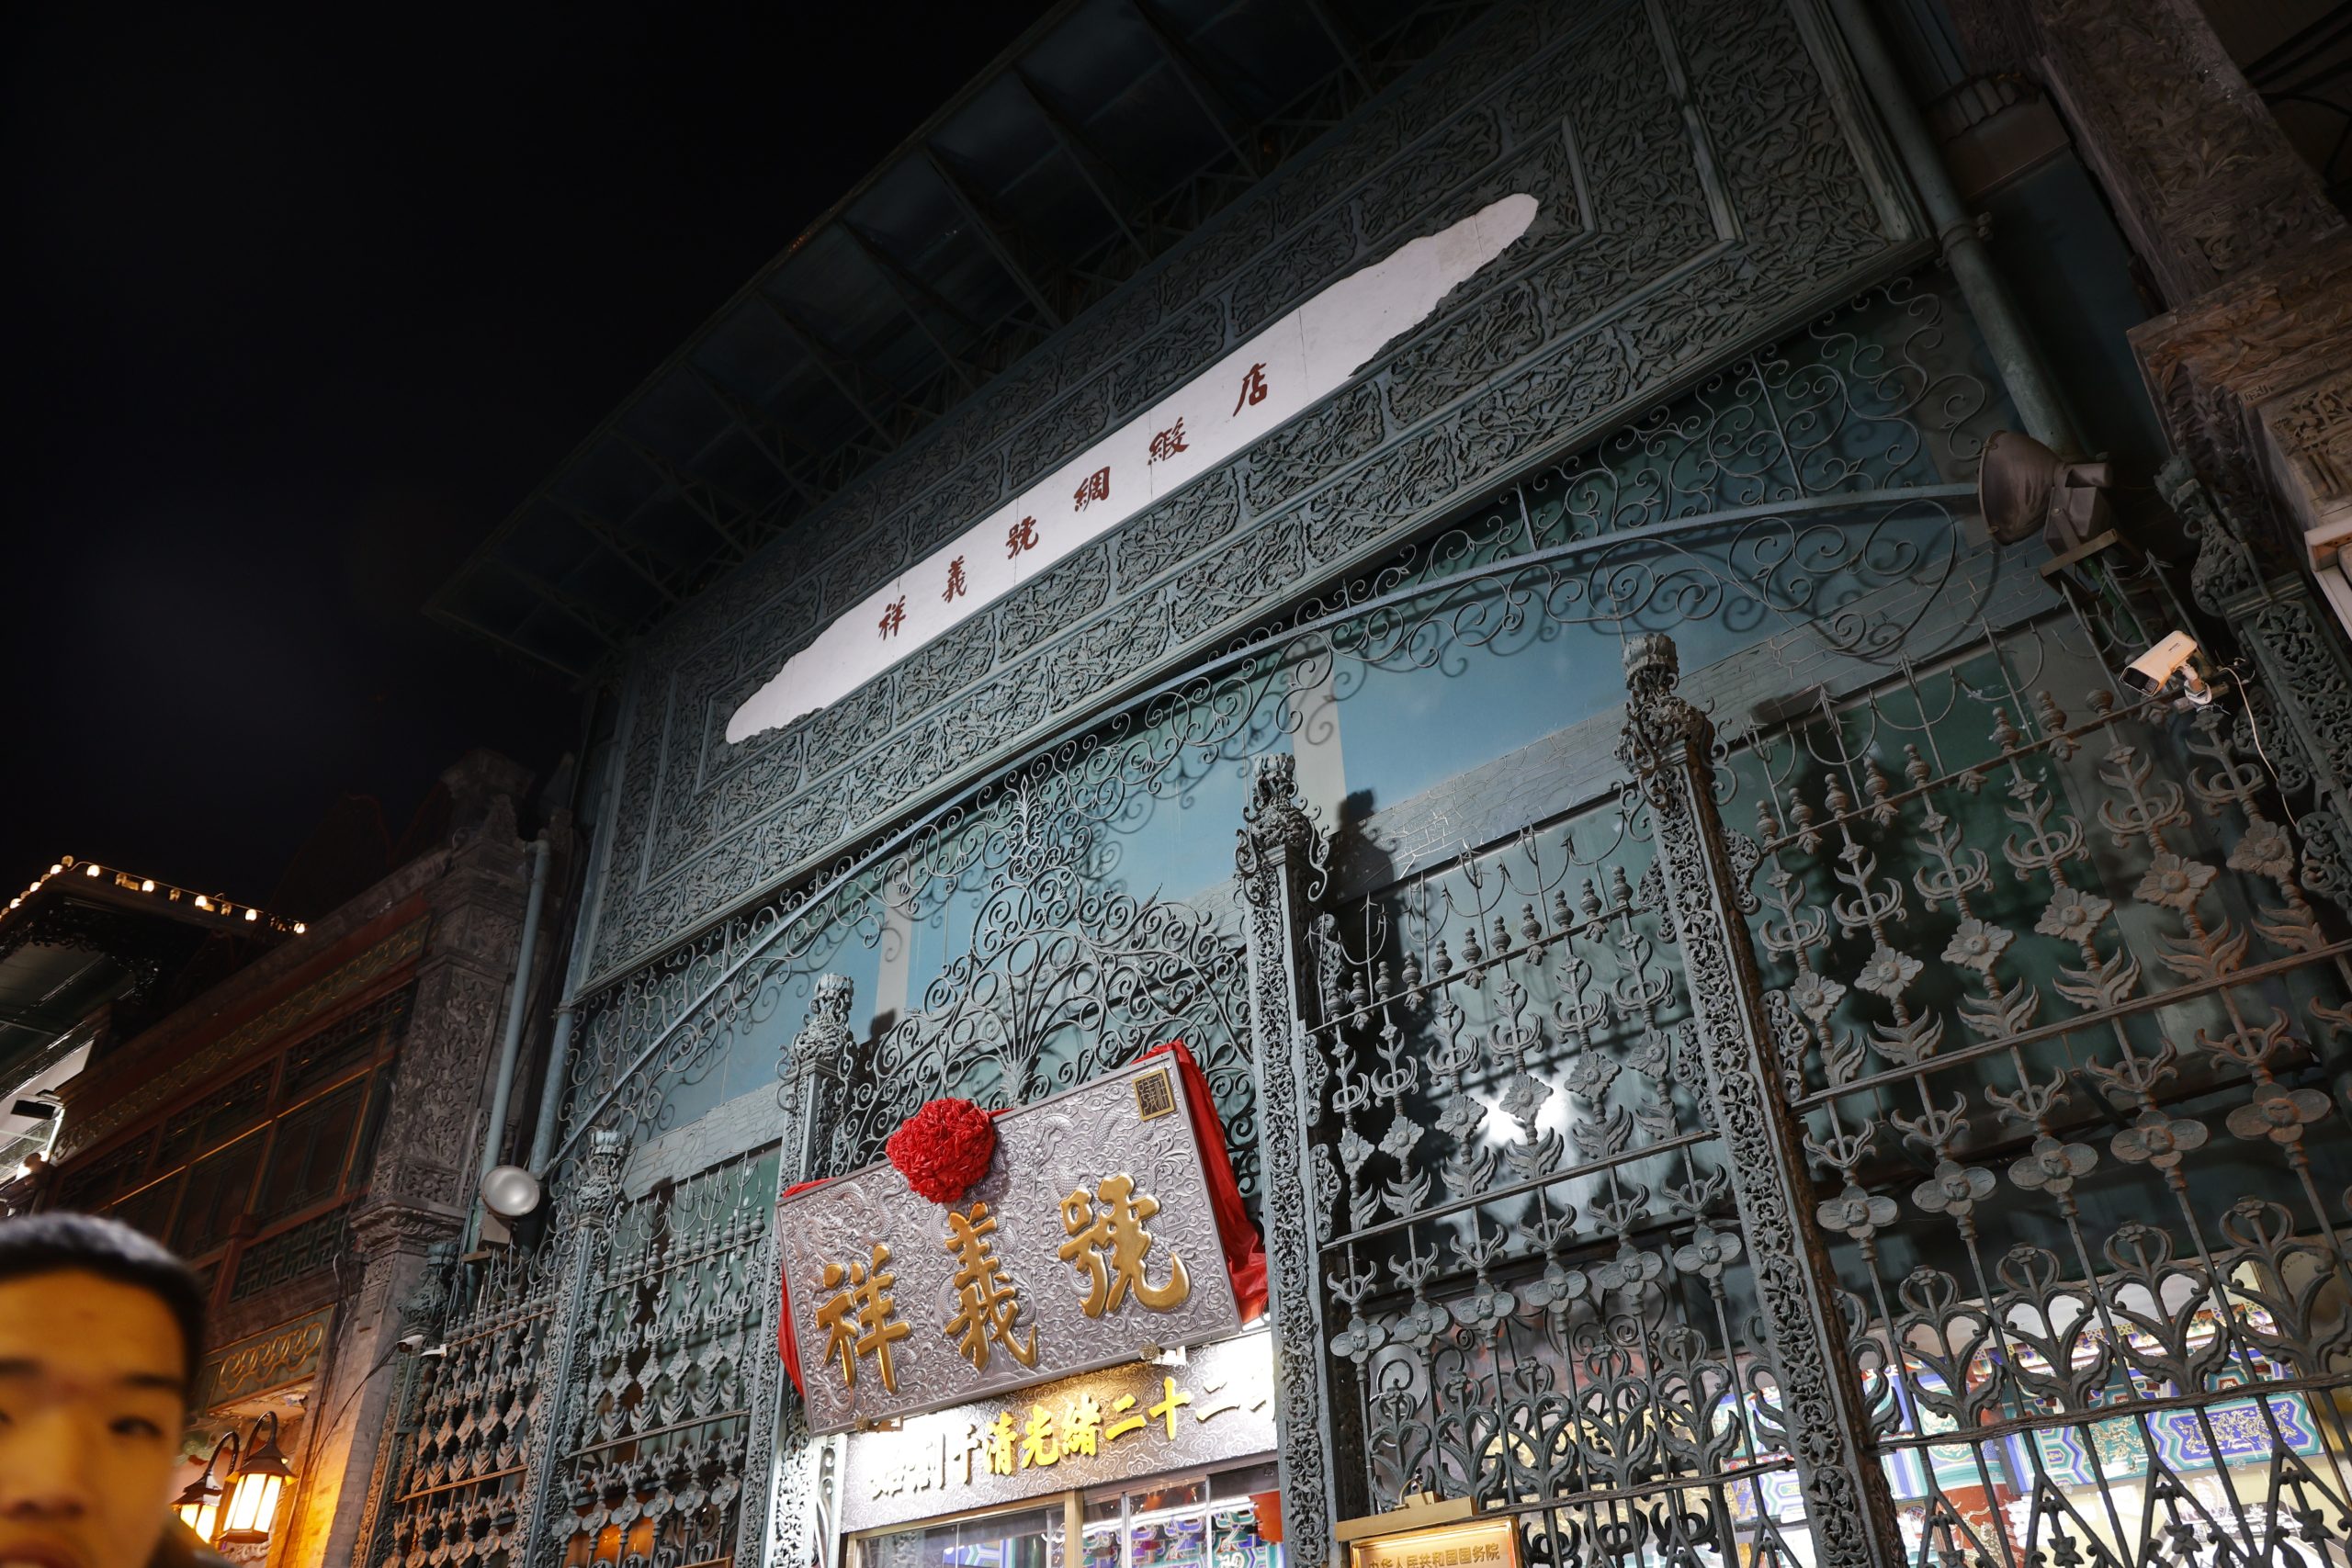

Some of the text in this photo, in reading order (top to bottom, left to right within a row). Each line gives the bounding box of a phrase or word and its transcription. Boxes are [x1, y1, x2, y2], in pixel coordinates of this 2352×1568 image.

[816, 1171, 1191, 1394] 祥義號
[868, 1374, 1275, 1502] 于清光緒二十二
